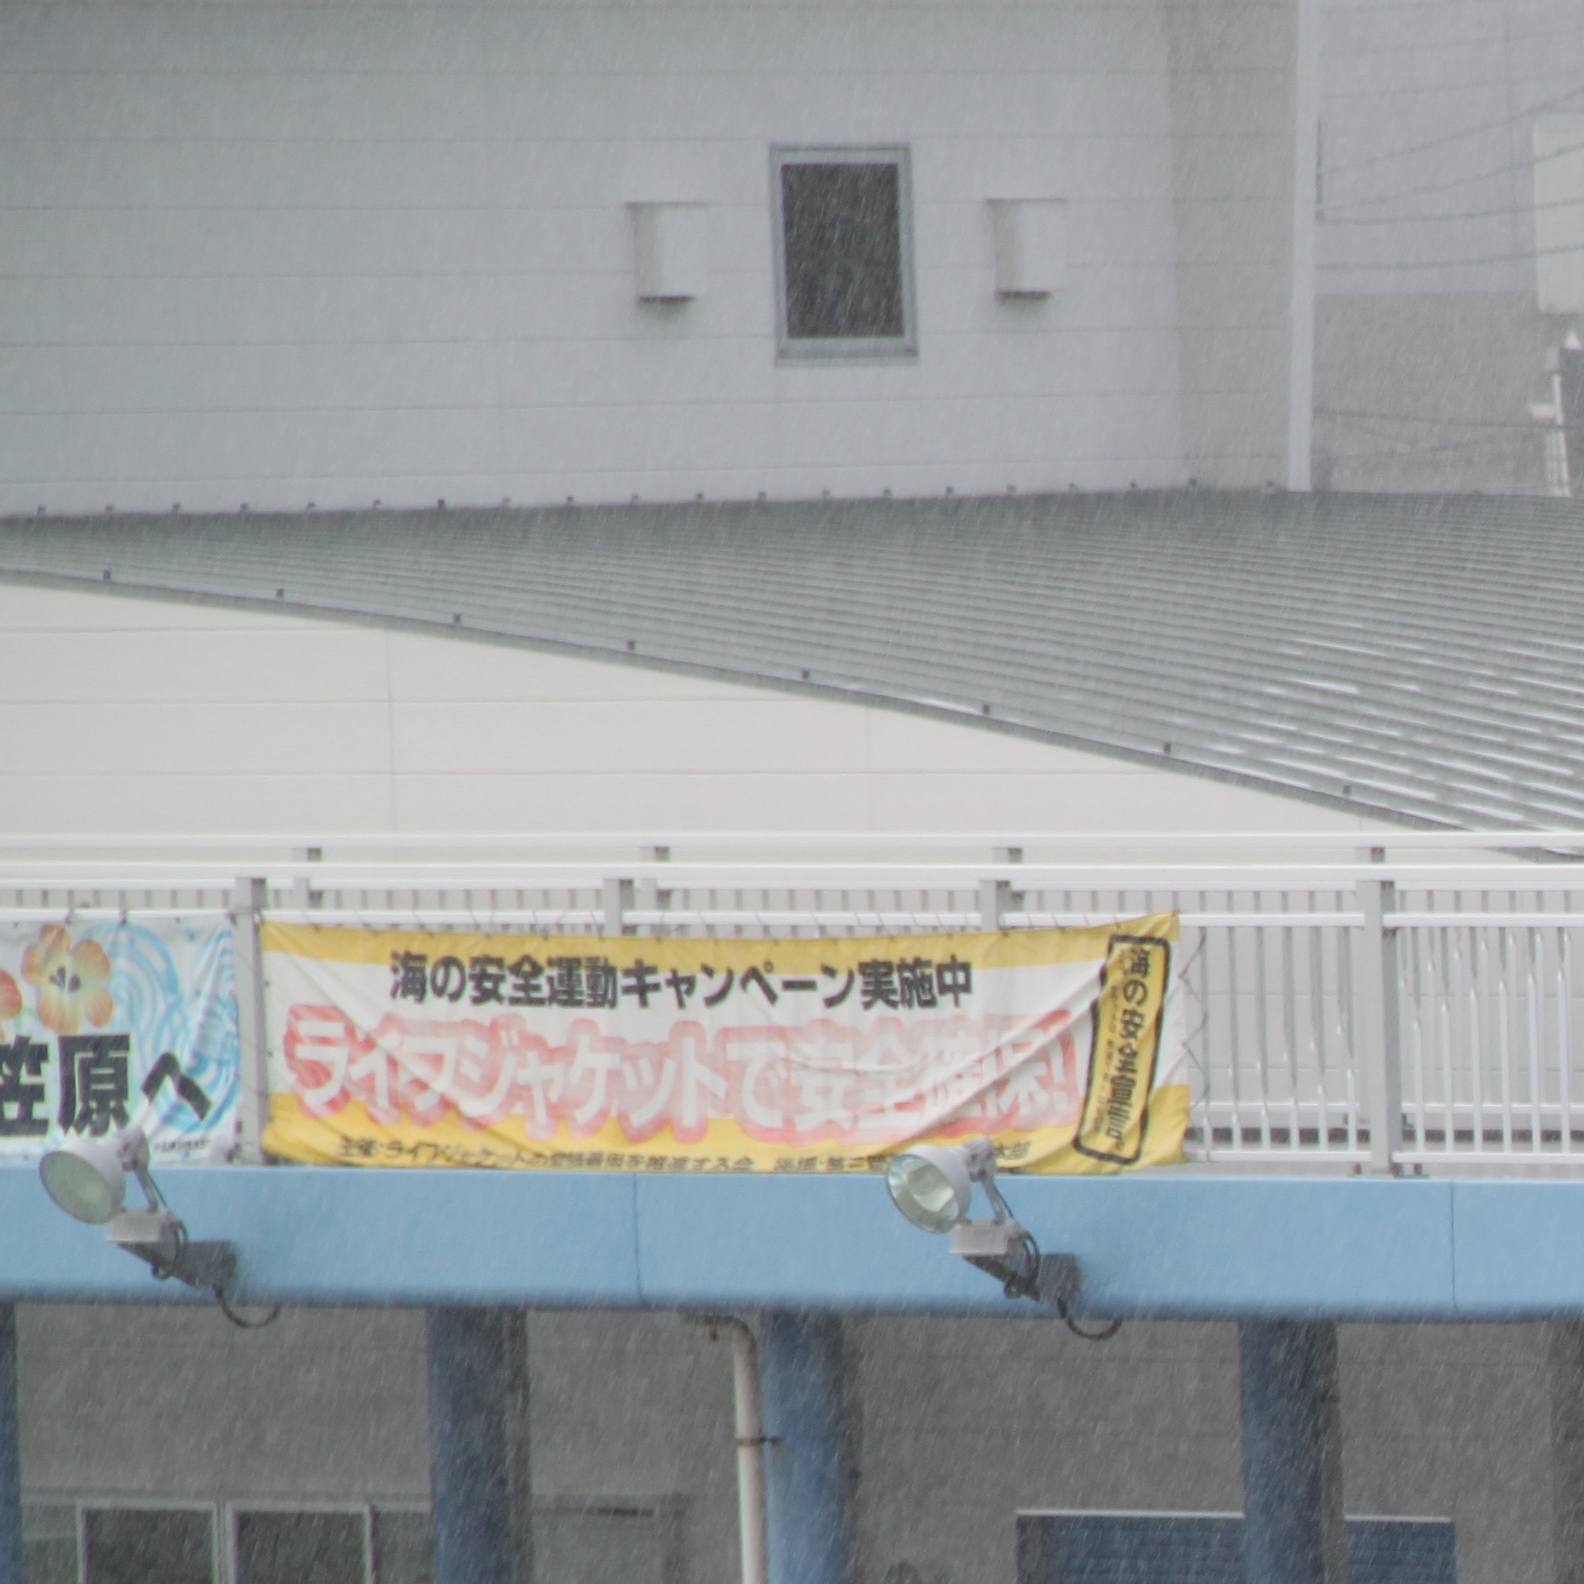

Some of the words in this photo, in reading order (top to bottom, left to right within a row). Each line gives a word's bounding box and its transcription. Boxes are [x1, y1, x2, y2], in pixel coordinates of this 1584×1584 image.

[389, 950, 973, 1010] 海の安全運動キャンペーン実施中
